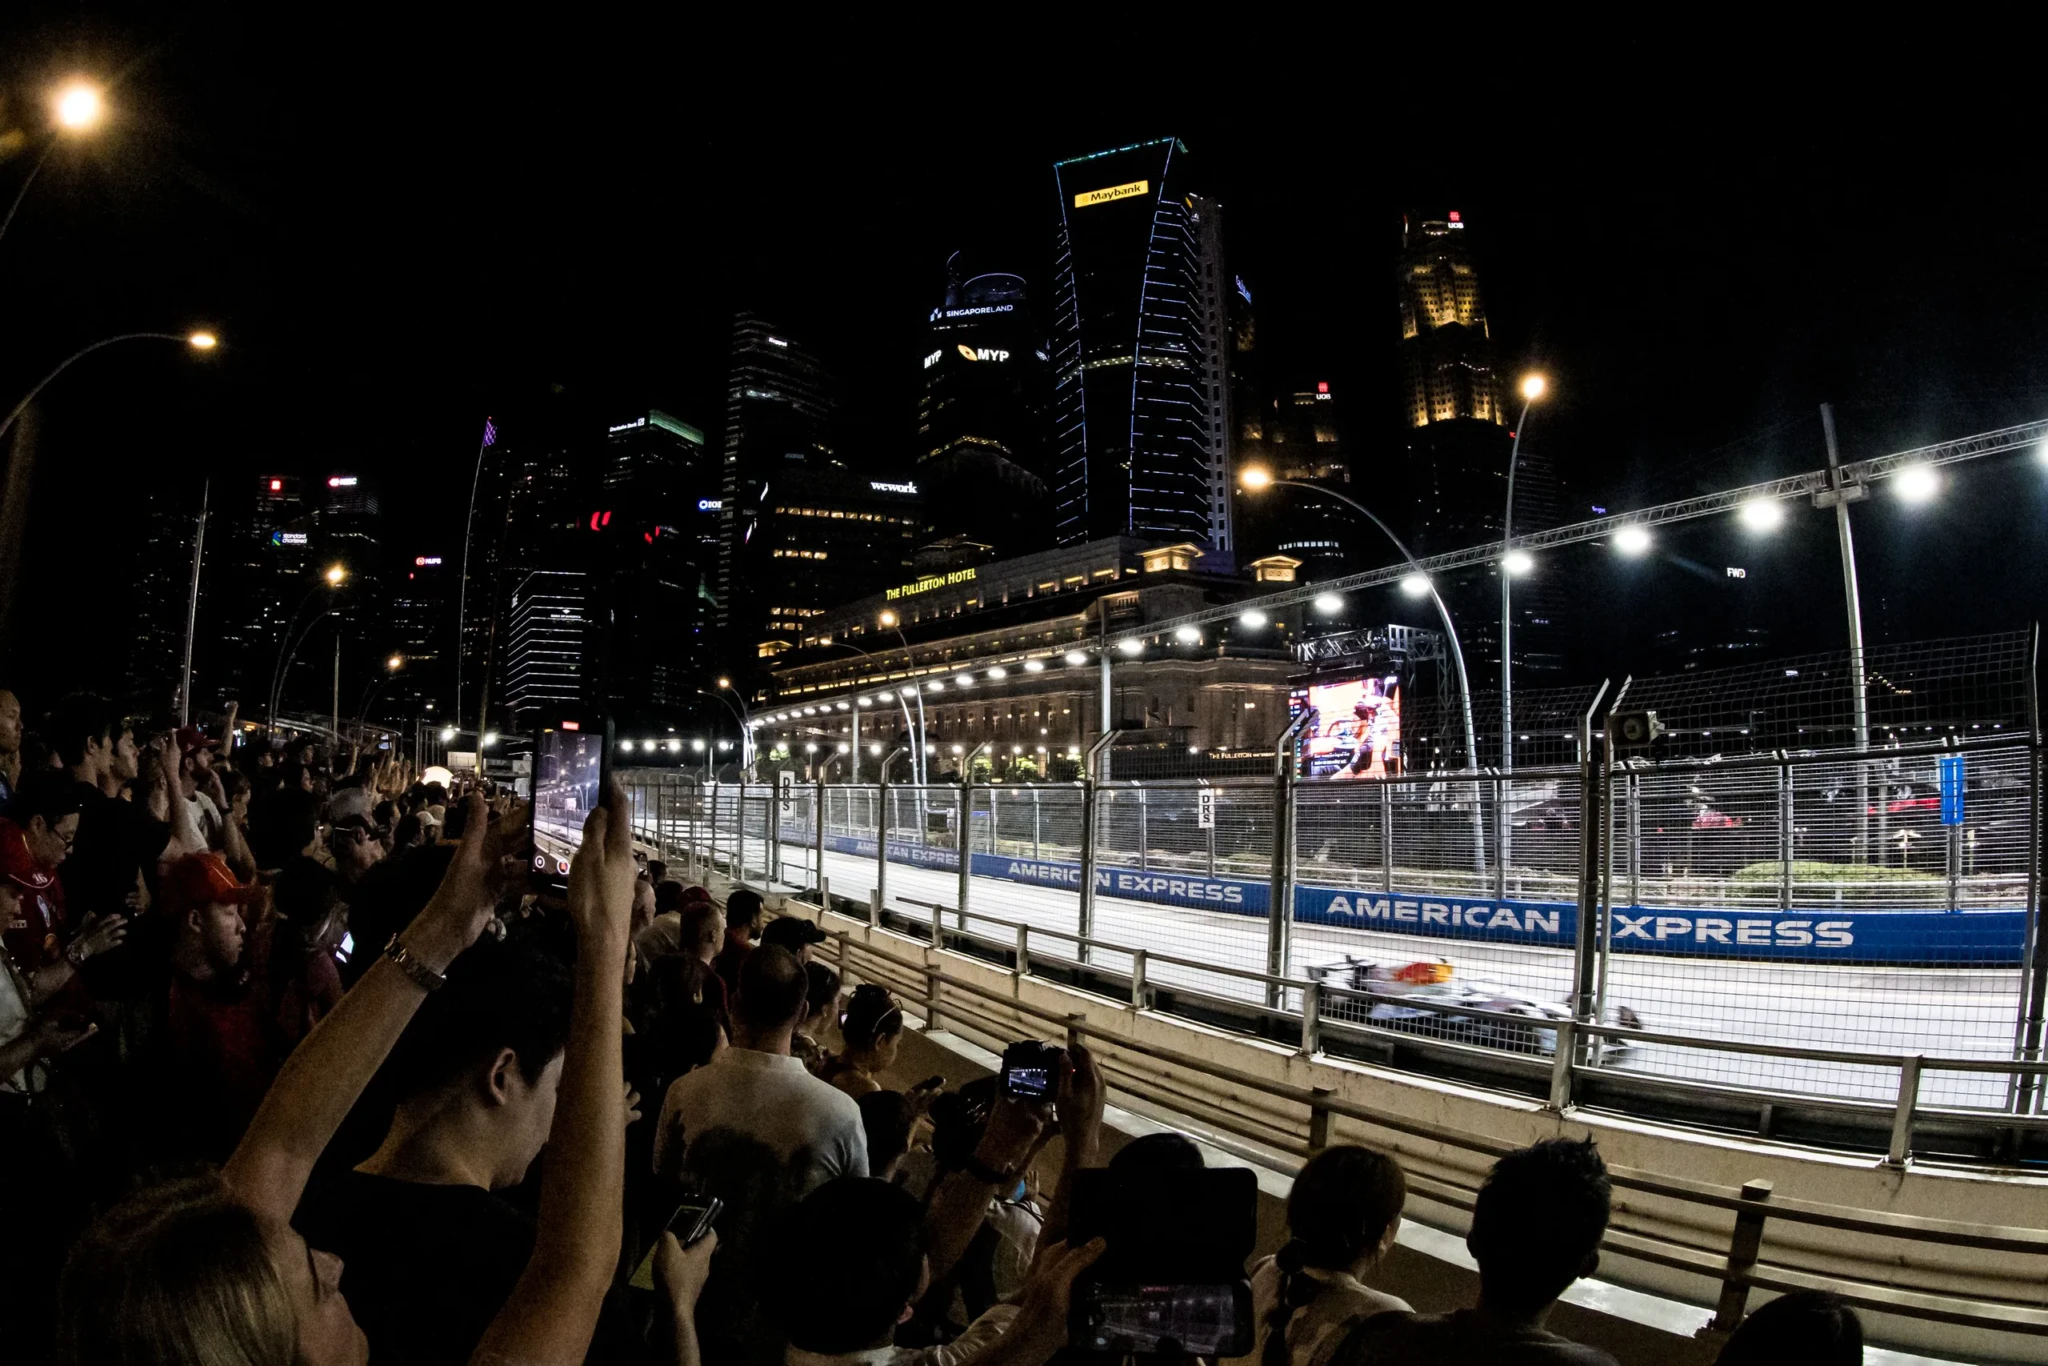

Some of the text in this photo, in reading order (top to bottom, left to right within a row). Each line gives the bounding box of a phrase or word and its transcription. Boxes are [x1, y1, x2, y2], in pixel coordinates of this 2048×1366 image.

[1091, 184, 1141, 201] Maybank
[946, 304, 1013, 317] SINGAPORELAND
[924, 349, 942, 369] MYP
[977, 348, 1009, 362] MYP
[870, 481, 918, 494] wework
[1727, 567, 1746, 578] FWD
[886, 567, 977, 600] THE FULLERTON HOTEL
[1202, 795, 1210, 823] DRS
[32, 873, 48, 885] 16
[1008, 861, 1243, 904] AMERICN EXPRESS
[1326, 895, 1853, 948] AMERICAN XPRESS
